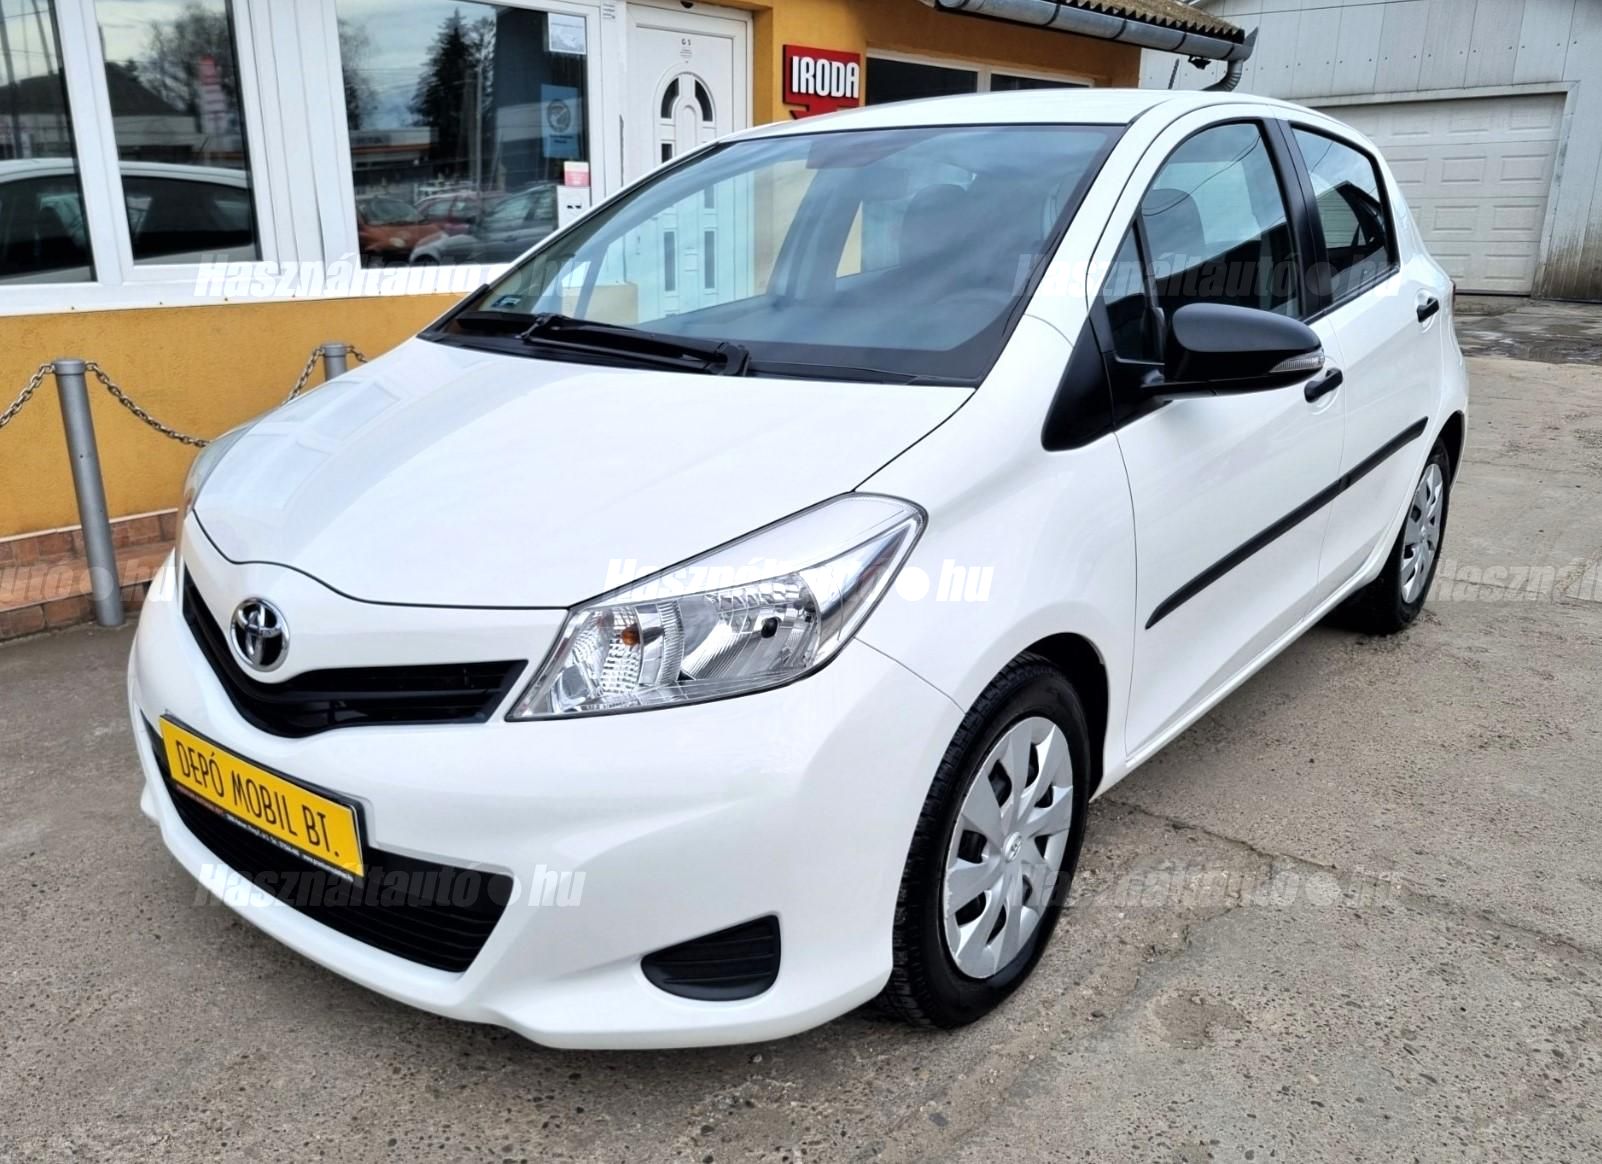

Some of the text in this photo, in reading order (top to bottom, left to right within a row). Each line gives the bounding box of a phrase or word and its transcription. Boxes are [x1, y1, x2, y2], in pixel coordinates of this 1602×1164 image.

[792, 55, 860, 99] IRODA
[175, 739, 225, 798] DEPÓ
[231, 770, 298, 837] MOBIL
